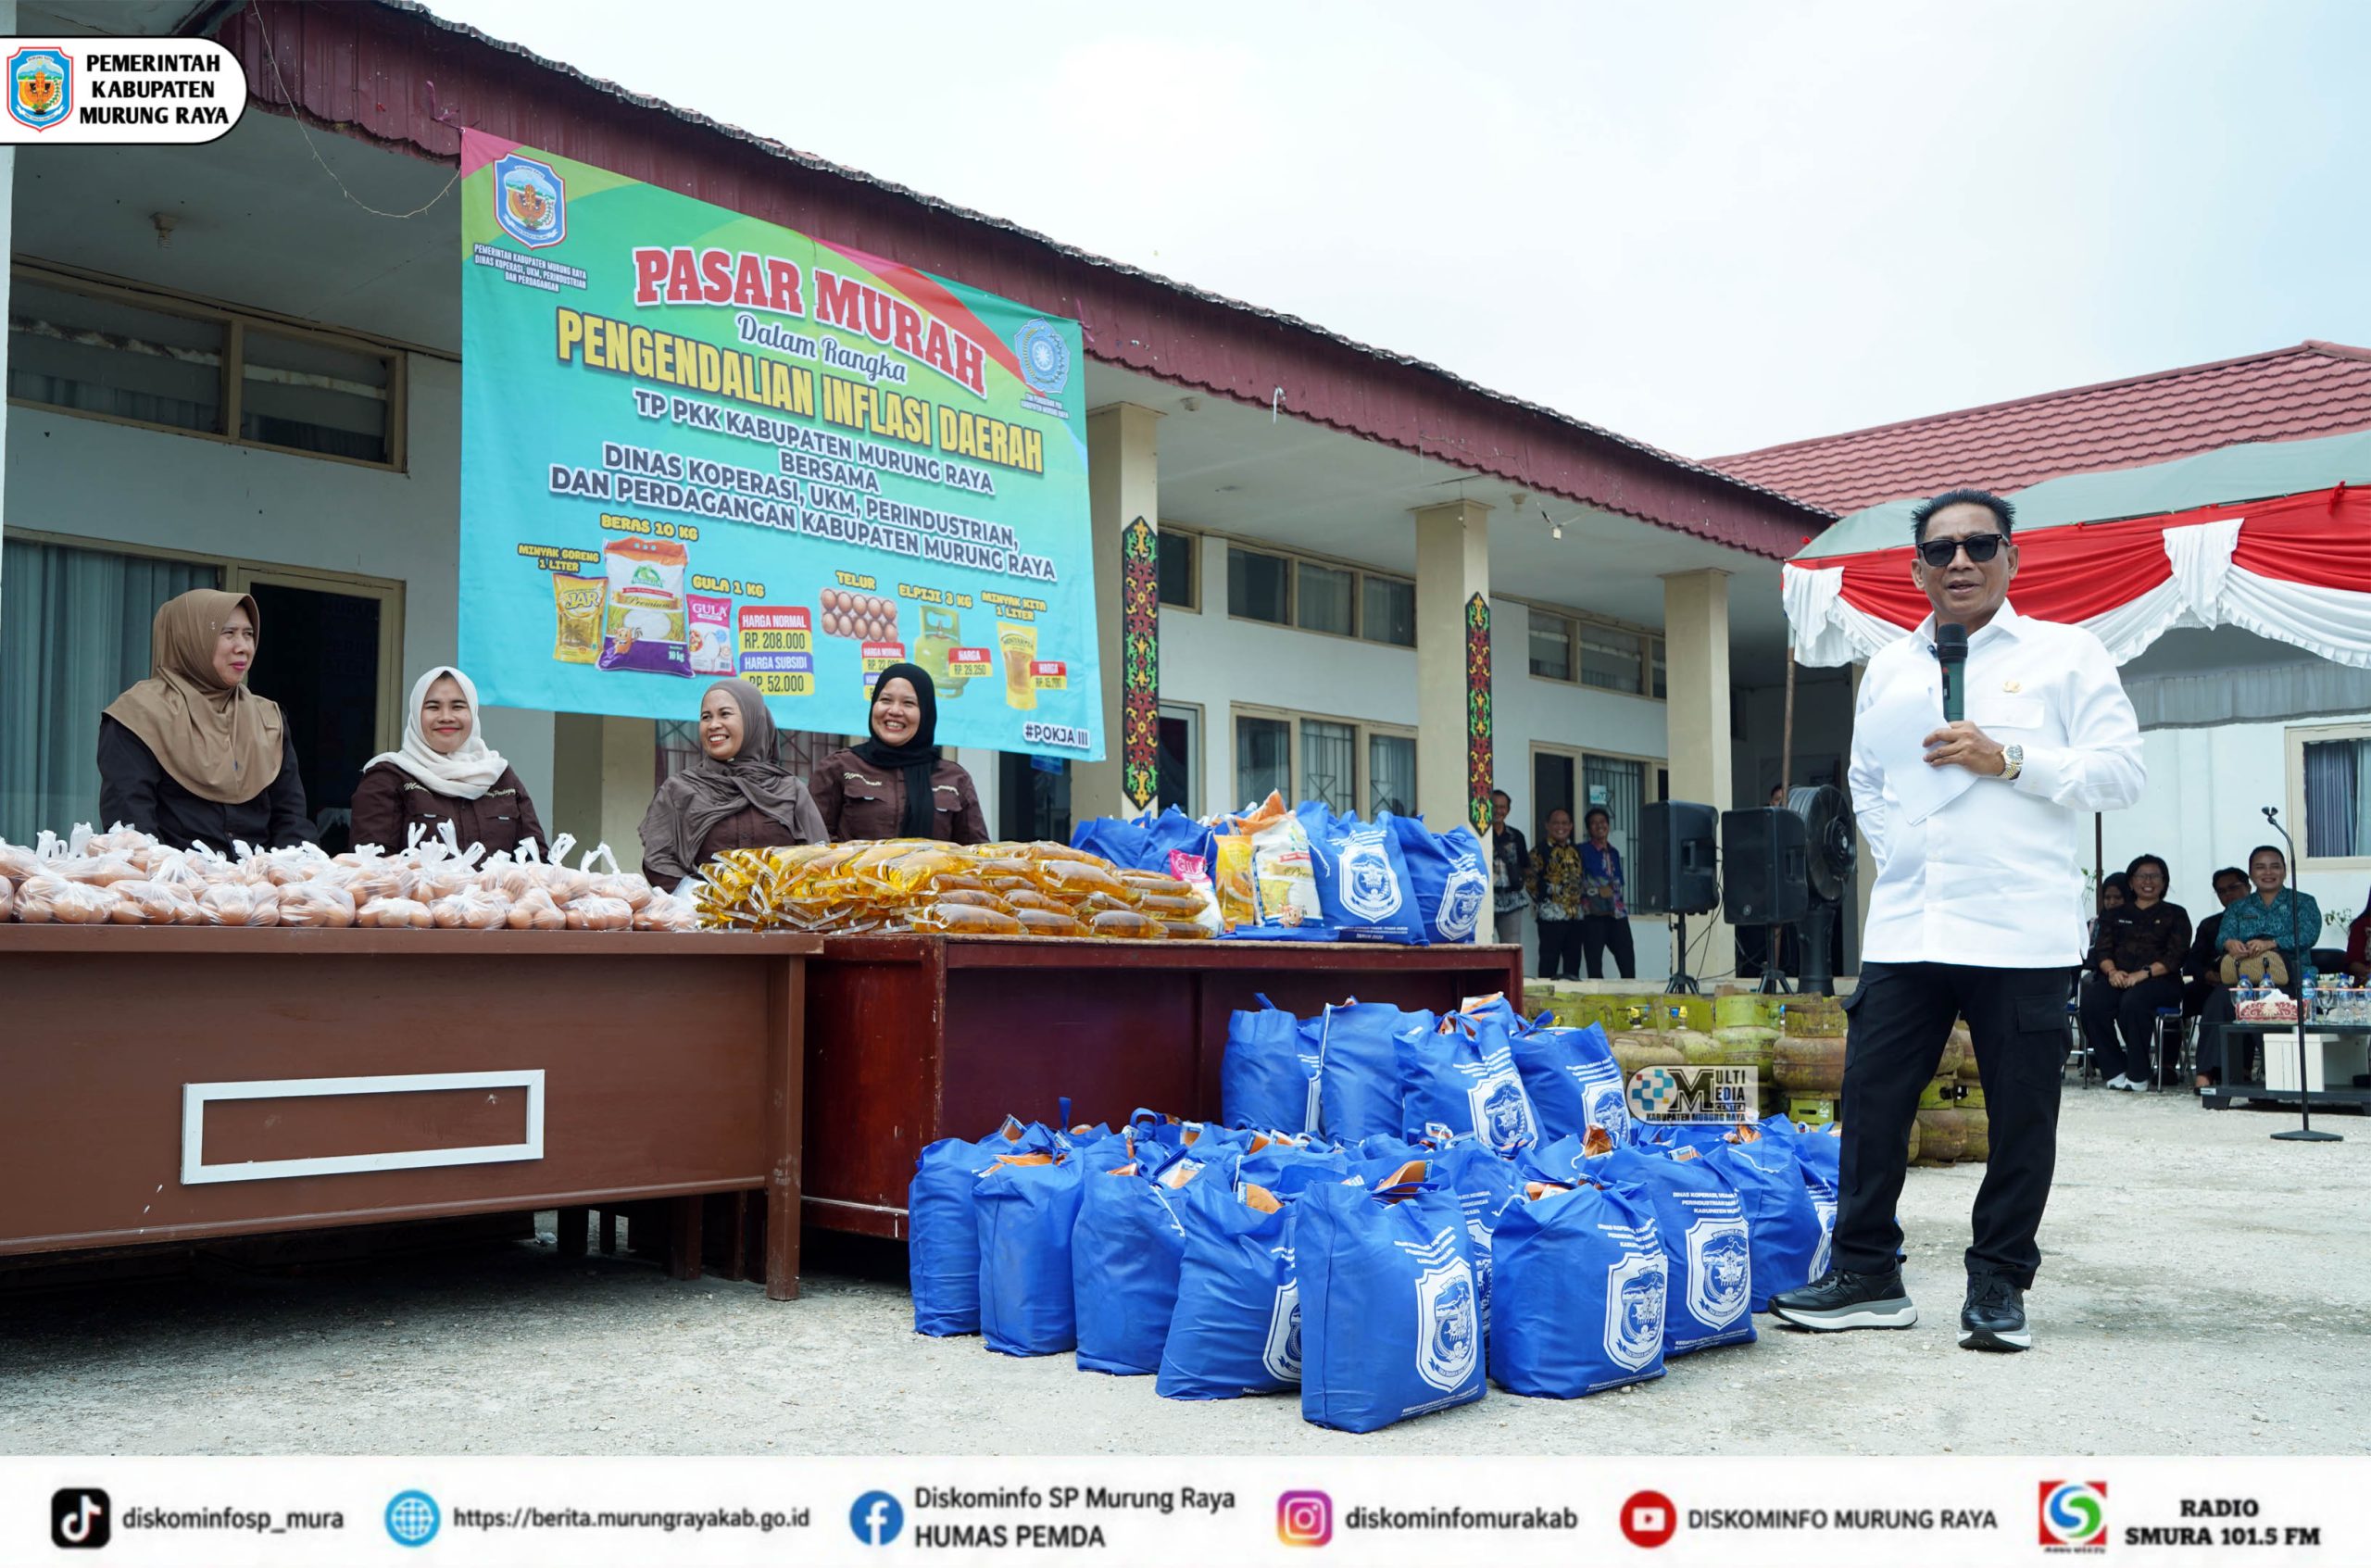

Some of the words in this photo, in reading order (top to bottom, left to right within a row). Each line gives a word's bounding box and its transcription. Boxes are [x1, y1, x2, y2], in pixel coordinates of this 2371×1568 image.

[474, 244, 512, 260] PEMERINTAH
[512, 253, 546, 269] KABUPATEN
[546, 260, 571, 275] MURUNG
[571, 268, 587, 280] RAYA
[474, 254, 495, 267] DINAS
[495, 258, 525, 275] KOPERASI,
[543, 270, 587, 289] PERINDUSTRIAN
[505, 271, 517, 282] DAN
[518, 274, 560, 293] PERDAGANGAN
[634, 248, 804, 316] PASAR
[813, 268, 986, 397] MURAH
[737, 314, 816, 358] Dalam
[822, 337, 907, 383] Rangka
[557, 307, 815, 418] PENGENDALIAN
[822, 373, 933, 448] INFLASI
[937, 405, 1044, 474] DAERAH
[634, 389, 667, 415] TP
[673, 399, 721, 430] PKK
[726, 410, 852, 459] KABUPATEN
[858, 442, 941, 481] MURUNG
[946, 464, 995, 493] RAYA
[781, 451, 880, 493] BERSAMA
[605, 444, 683, 479] DINAS
[688, 458, 804, 507] KOPERASI,
[809, 485, 861, 519] UKM,
[866, 498, 1019, 552] PERINDUSTRIAN,
[551, 466, 609, 496] DAN
[617, 477, 797, 529] PERDAGANGAN
[801, 511, 920, 554] KABUPATEN
[923, 537, 1003, 571] MURUNG
[1008, 554, 1057, 581] RAYA
[600, 514, 650, 533] BERAS
[655, 521, 674, 536] 10
[679, 525, 699, 541] KG
[518, 544, 559, 558] MINYAK
[561, 548, 600, 563] GORENG
[538, 558, 546, 570] 1
[548, 559, 580, 572] LITER
[692, 574, 730, 593] GULA
[734, 581, 743, 595] 1
[746, 583, 766, 598] KG
[835, 571, 877, 591] TELUR
[897, 583, 943, 603] ELPIJI
[946, 593, 954, 605] 3
[957, 594, 972, 608] KG
[982, 591, 1021, 608] MINYAK
[1022, 596, 1048, 612] KITA
[692, 603, 728, 618] GULA
[742, 614, 772, 629] HARGA
[772, 614, 808, 629] NORMAL
[996, 606, 1003, 617] 1
[1006, 608, 1035, 621] LITER
[744, 632, 760, 649] RP.
[762, 632, 806, 650] 208.000
[744, 656, 773, 671] HARGA
[774, 656, 808, 670] SUBSIDI
[767, 674, 805, 693] 52.000
[1025, 723, 1075, 745] #POKJA
[1077, 730, 1088, 746] III
